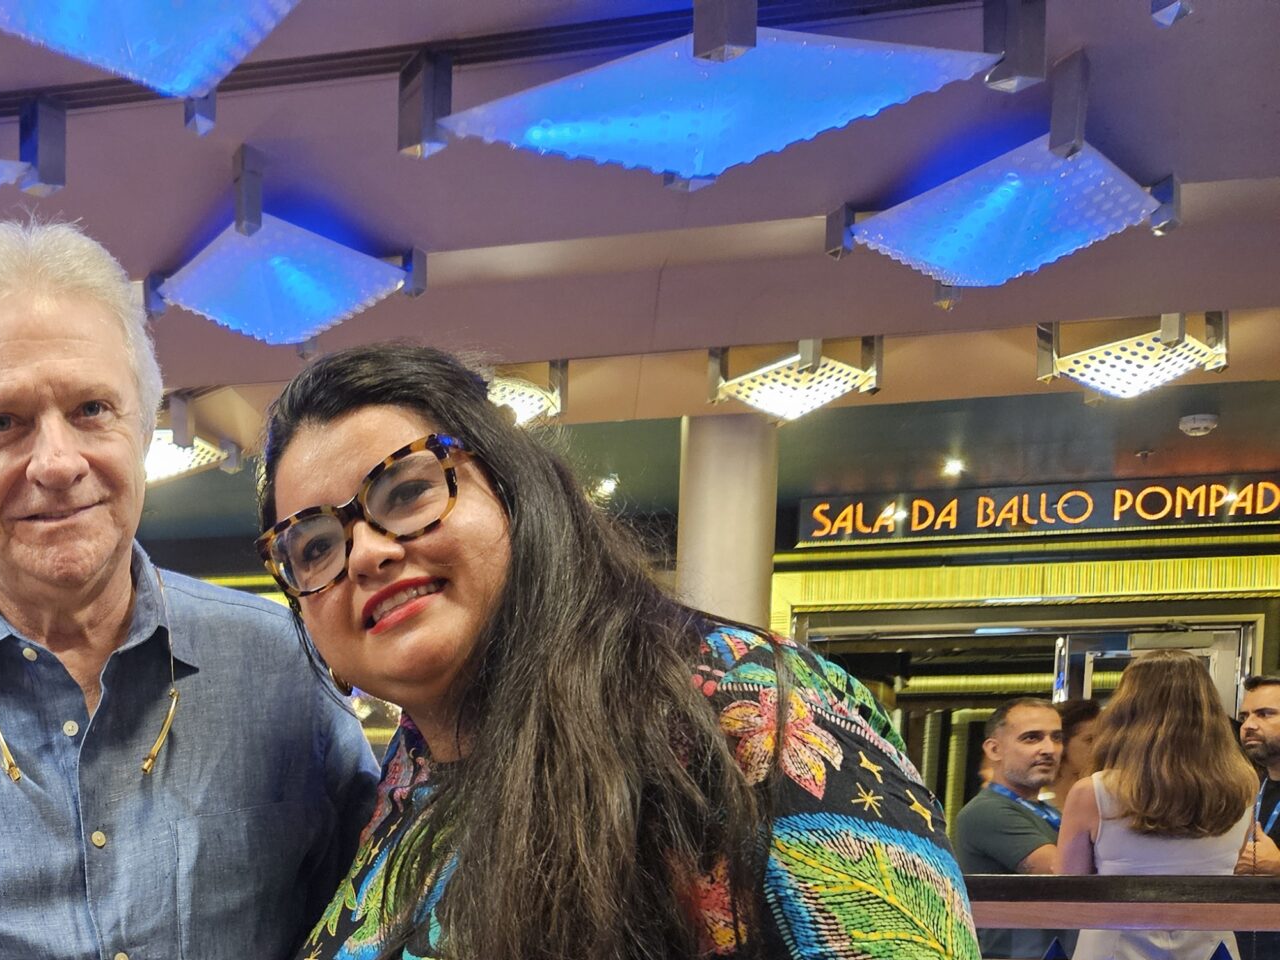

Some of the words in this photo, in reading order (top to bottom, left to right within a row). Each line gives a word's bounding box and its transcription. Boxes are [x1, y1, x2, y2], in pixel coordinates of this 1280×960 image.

[811, 501, 896, 537] SALA
[910, 498, 958, 532] DA
[976, 489, 1094, 528] BALLO
[1113, 481, 1280, 521] POMPAD
